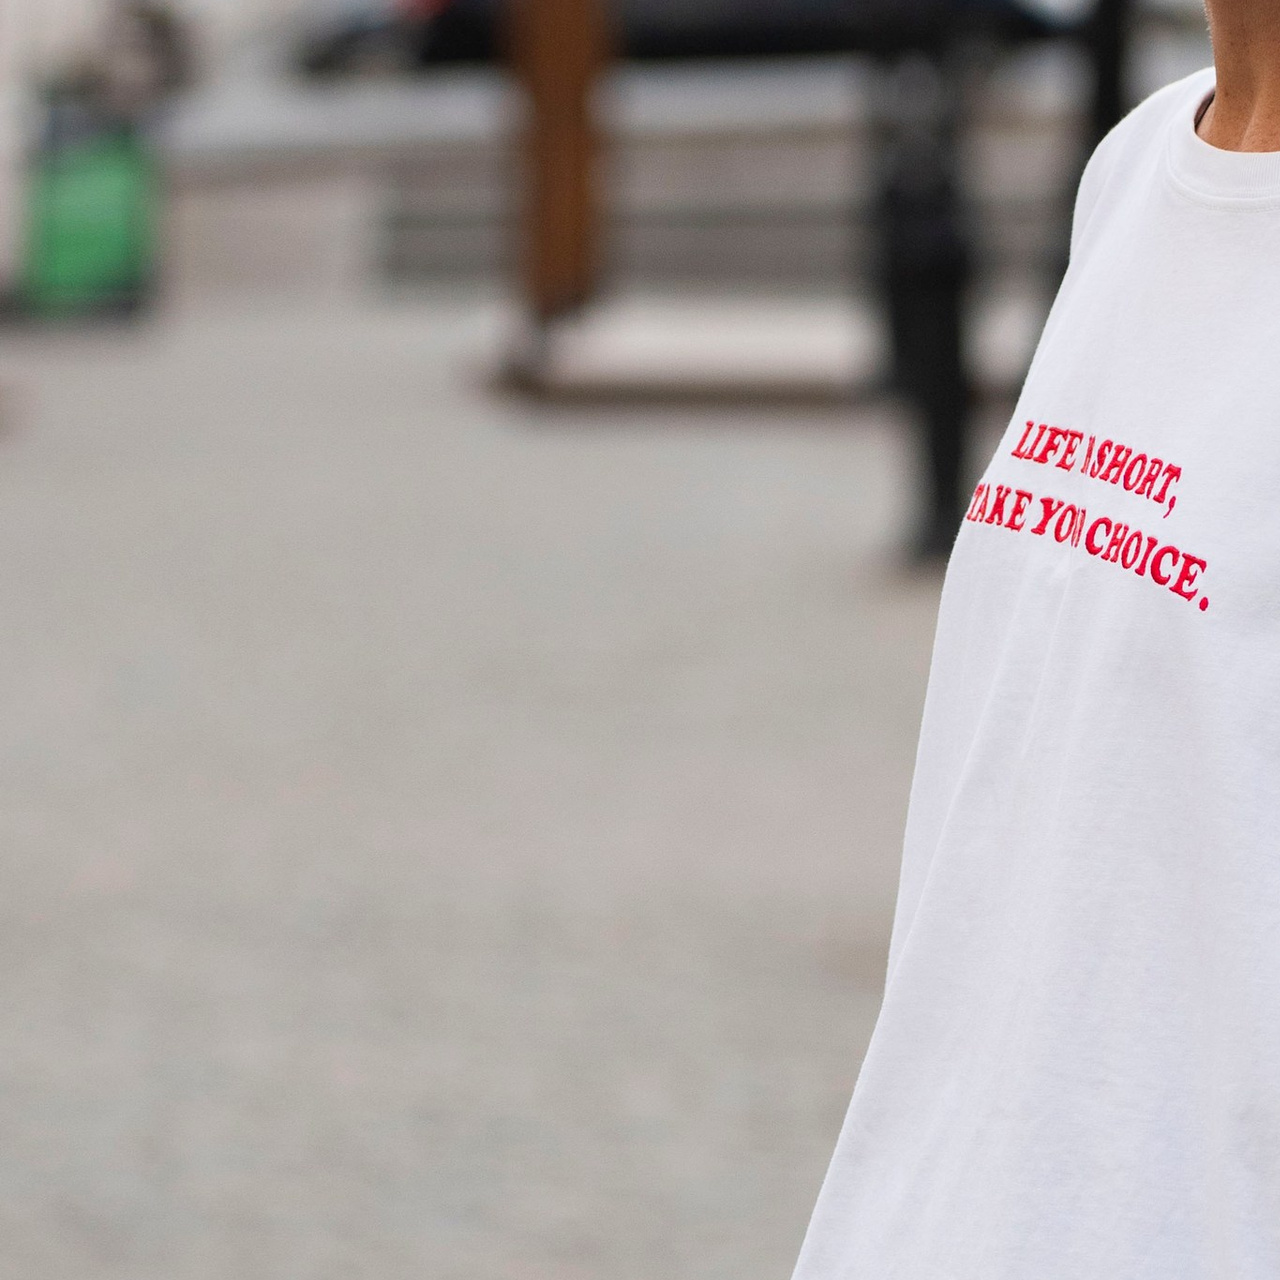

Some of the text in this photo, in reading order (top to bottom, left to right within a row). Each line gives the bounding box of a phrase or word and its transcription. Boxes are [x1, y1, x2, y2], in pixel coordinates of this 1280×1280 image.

[1011, 420, 1084, 472] LIFE
[1089, 438, 1183, 519] SHORT,
[1085, 516, 1210, 612] CHOICE.
